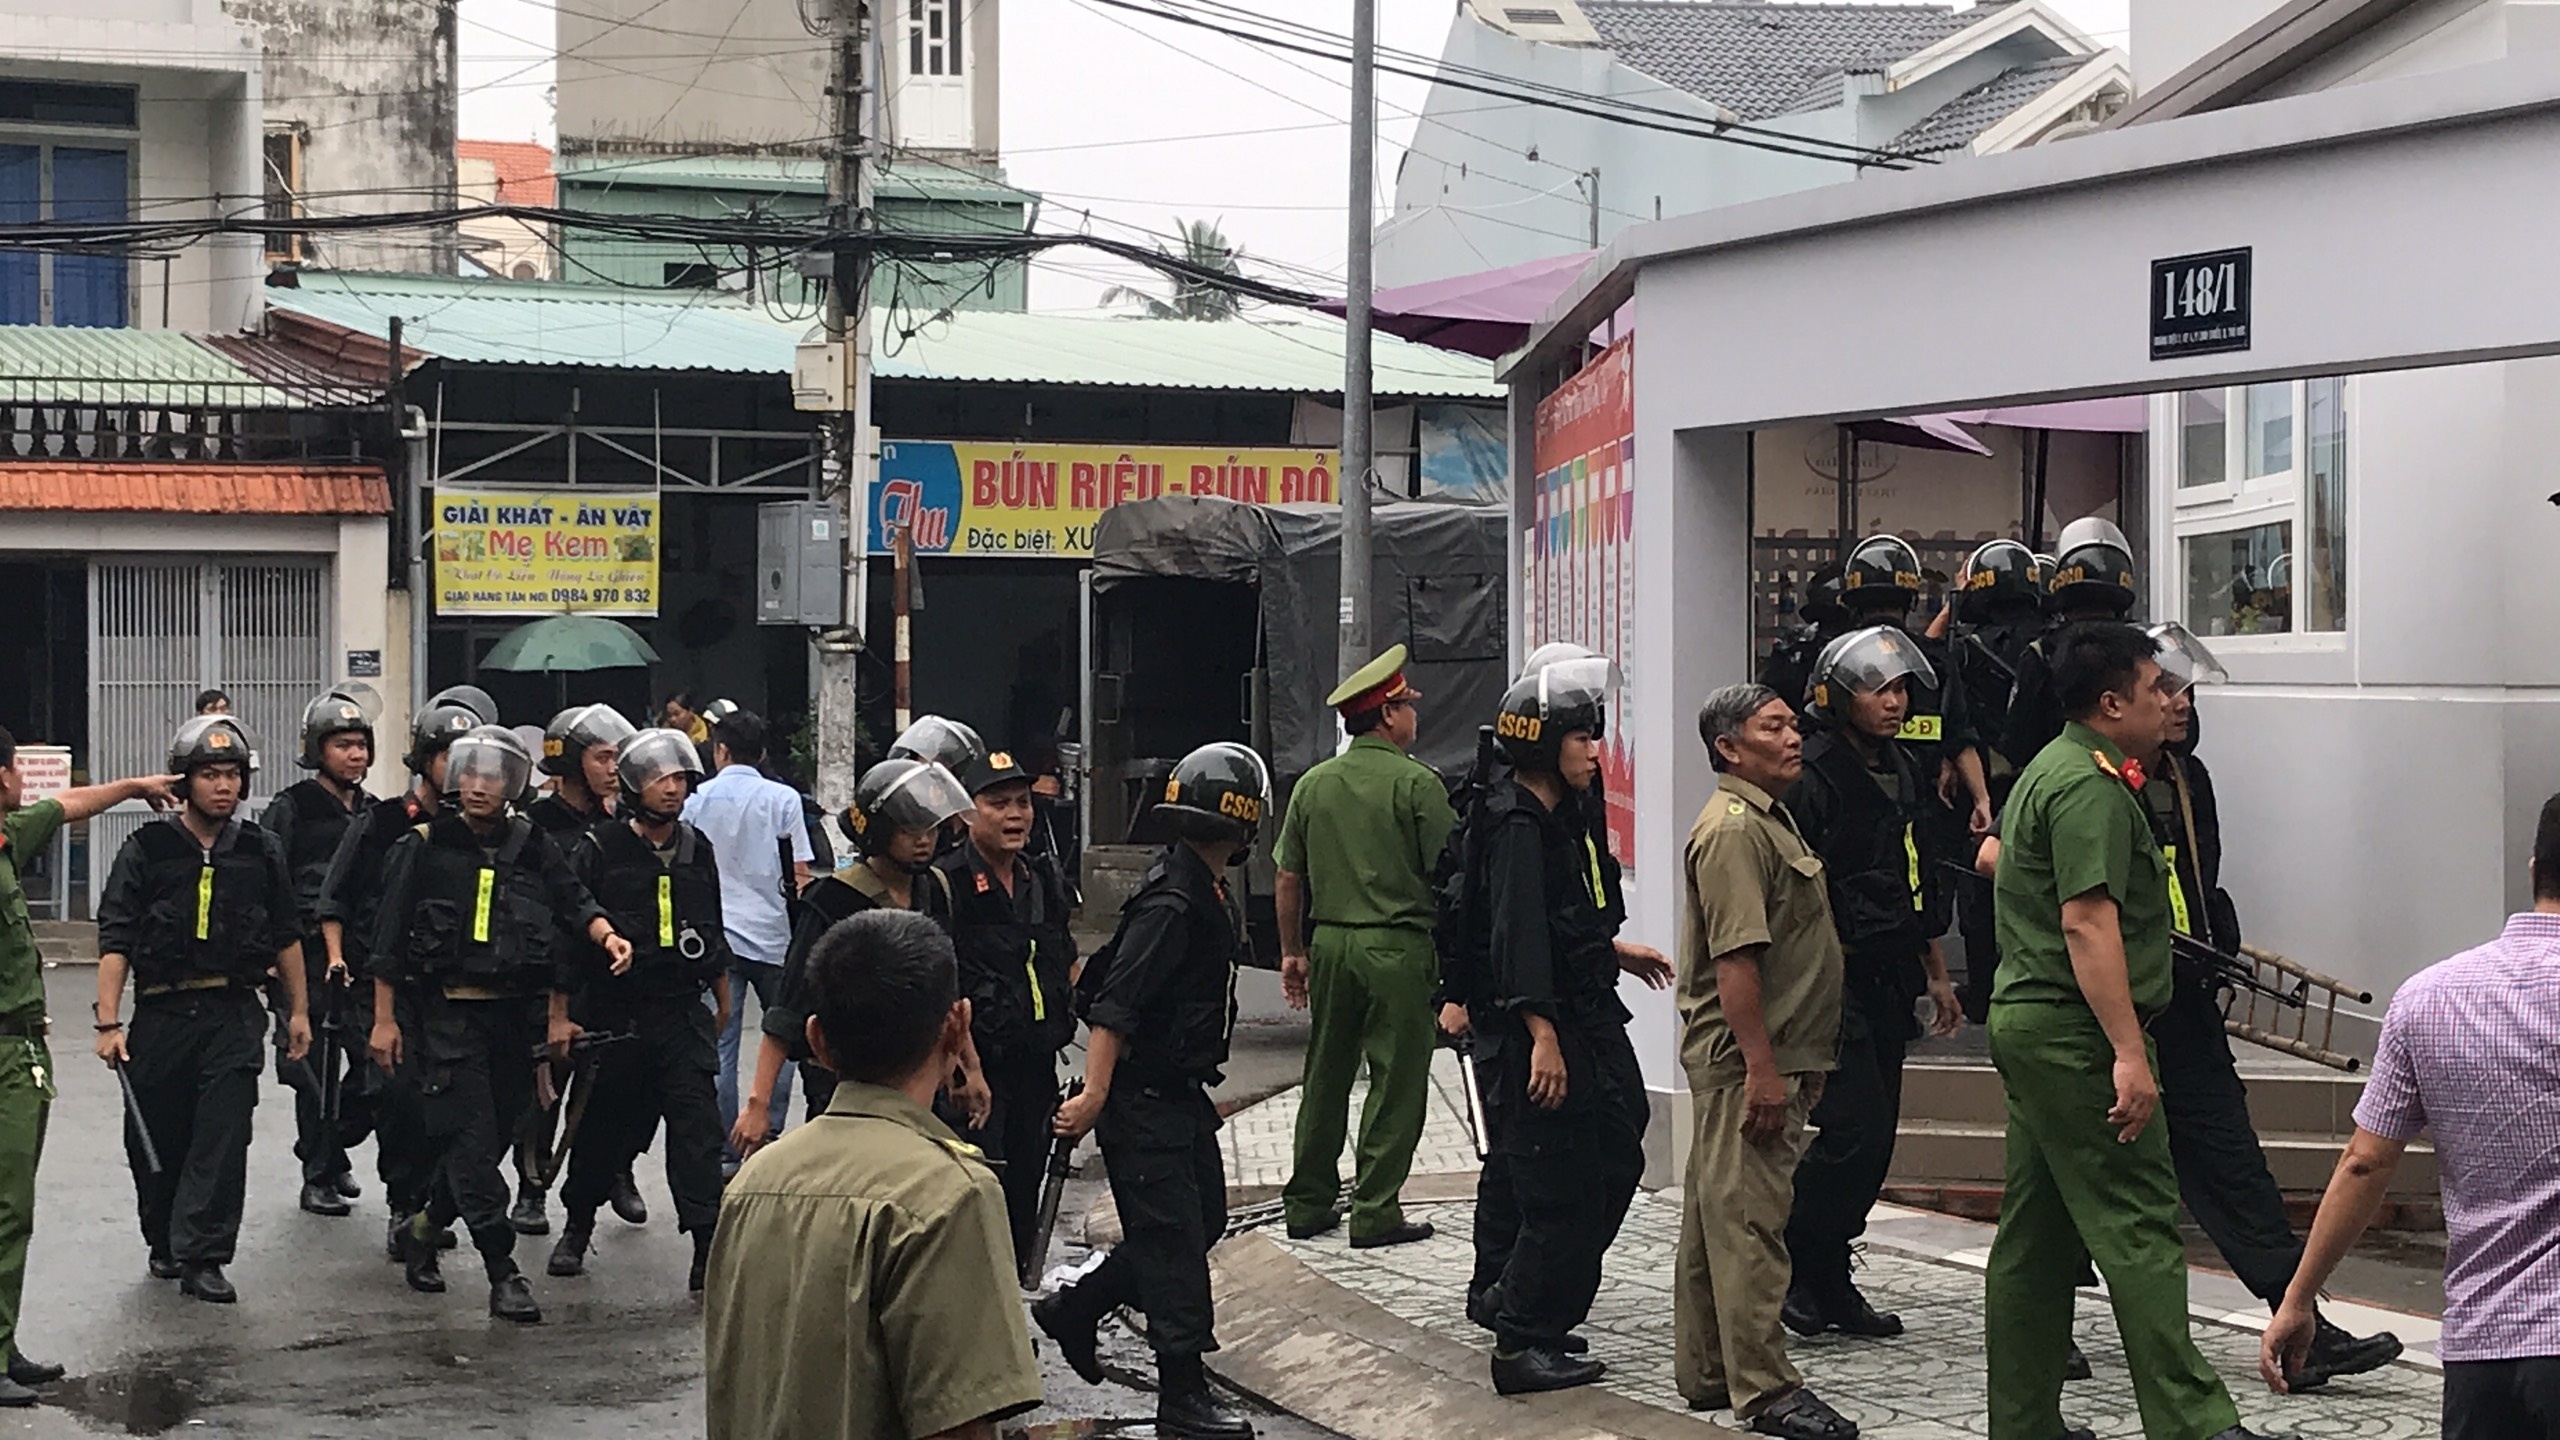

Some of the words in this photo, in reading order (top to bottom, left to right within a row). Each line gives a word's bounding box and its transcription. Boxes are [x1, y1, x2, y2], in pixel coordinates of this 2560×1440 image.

[2163, 262, 2237, 320] 148/1
[972, 450, 1058, 509] BÚN
[576, 503, 606, 526] ĂN
[489, 530, 533, 566] Mẹ
[544, 530, 609, 558] Kem
[967, 527, 1008, 553] Đặc
[1014, 528, 1056, 554] biệt:
[551, 588, 588, 602] 0984
[624, 588, 651, 603] 832
